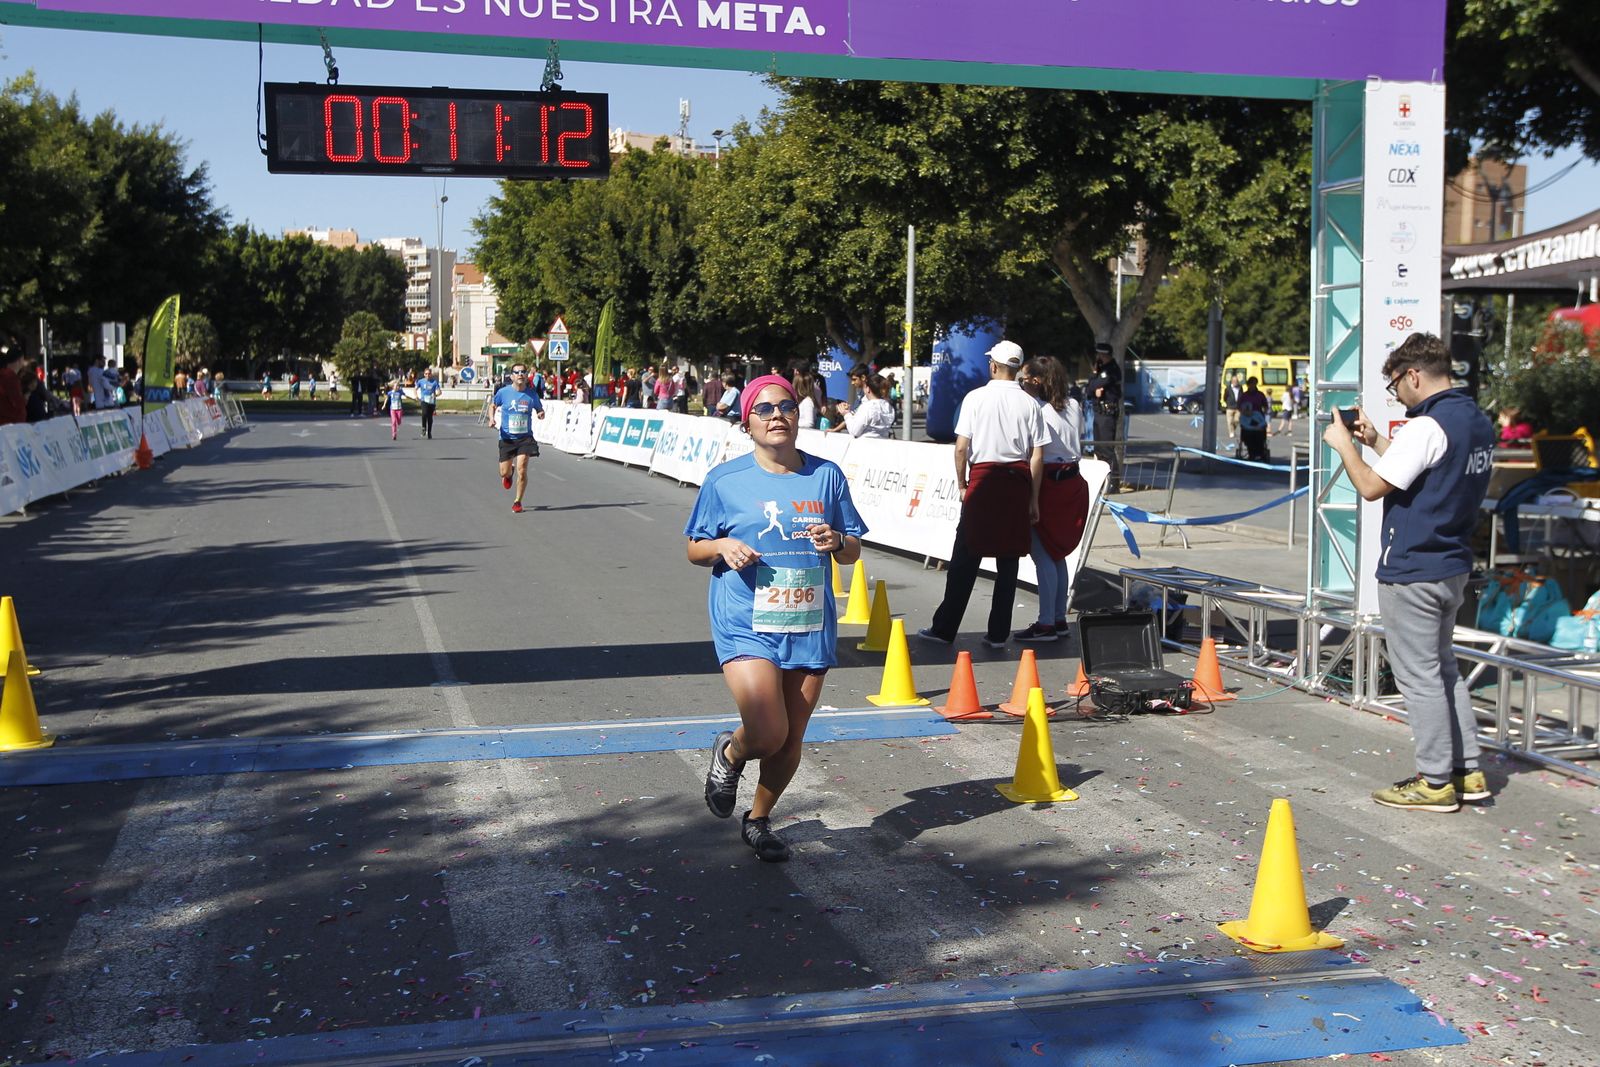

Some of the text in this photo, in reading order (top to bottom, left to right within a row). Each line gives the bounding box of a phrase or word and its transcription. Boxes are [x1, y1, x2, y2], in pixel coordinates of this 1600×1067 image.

[484, 0, 684, 28] NUESTRA
[697, 0, 826, 36] META.
[324, 94, 593, 168] 00:11:12
[1389, 143, 1421, 156] NEXA
[1388, 168, 1416, 184] CDX
[1390, 315, 1413, 331] ego
[931, 350, 950, 364] ERÍA
[791, 500, 825, 514] VIII
[767, 587, 815, 604] 2196
